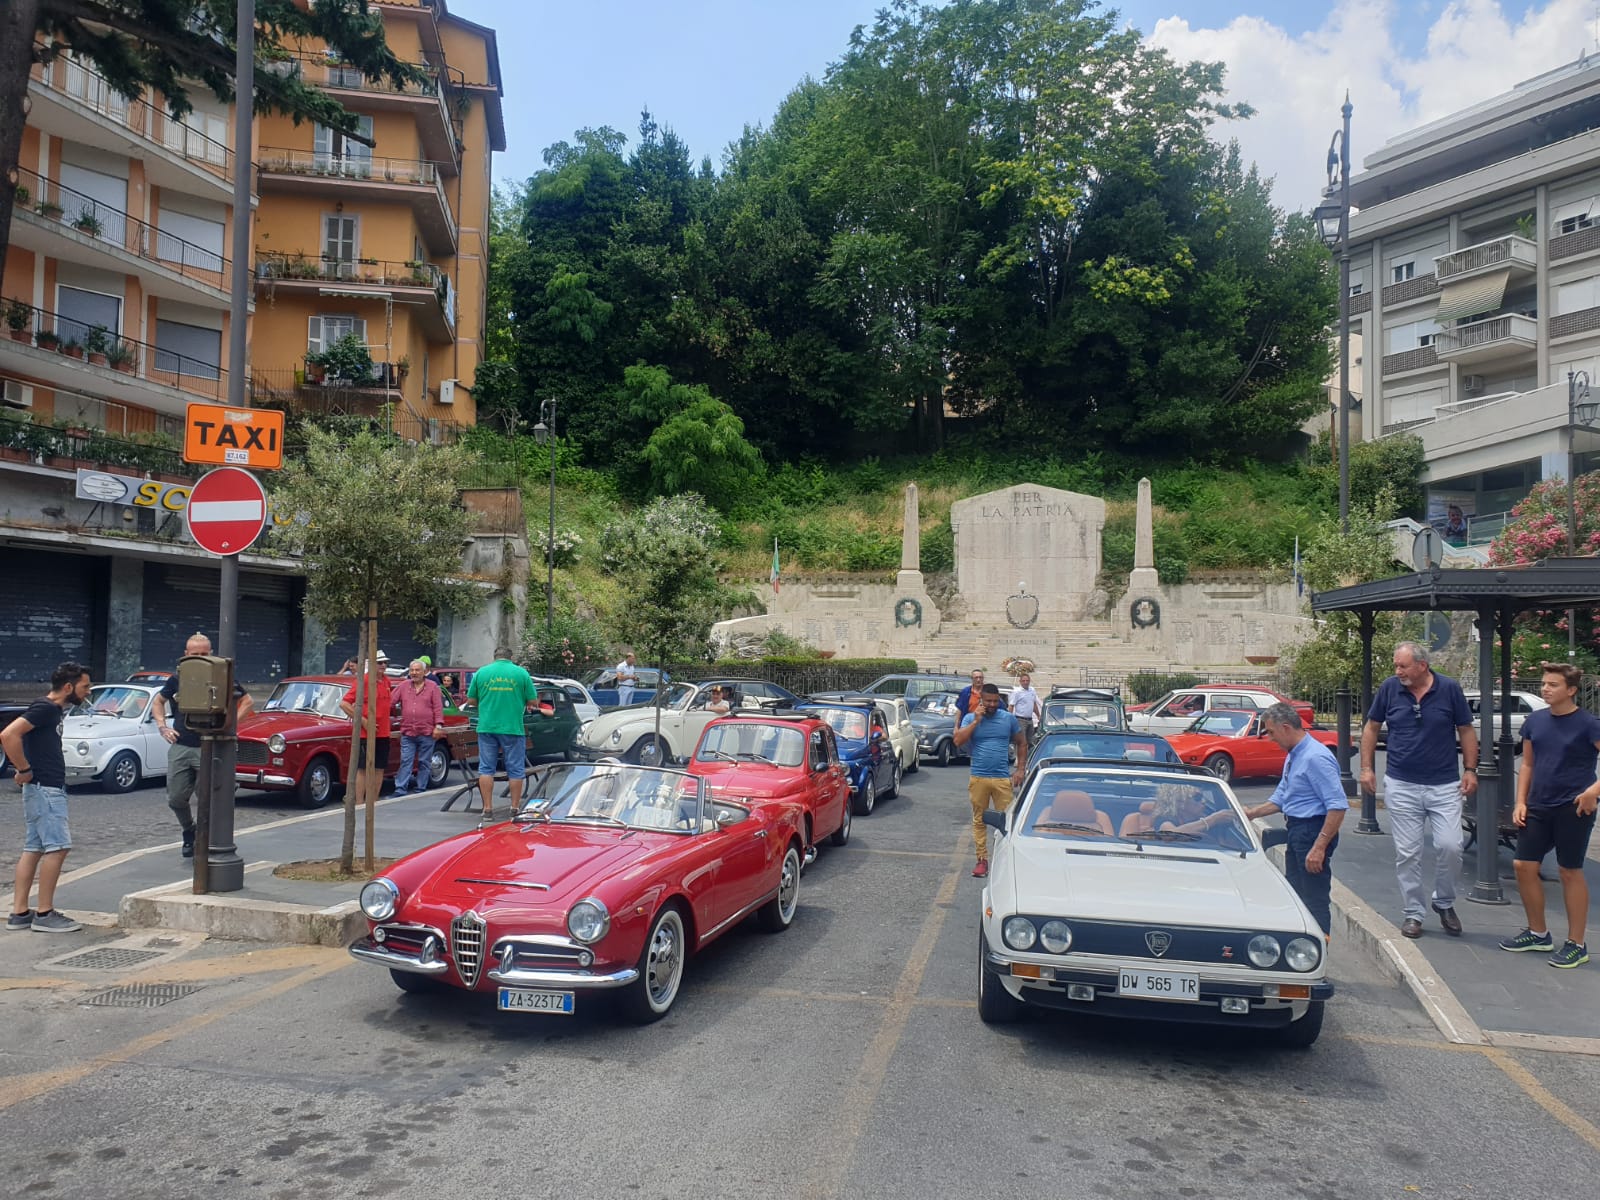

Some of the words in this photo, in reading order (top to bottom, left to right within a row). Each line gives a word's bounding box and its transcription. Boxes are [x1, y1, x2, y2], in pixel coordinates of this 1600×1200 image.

[194, 421, 276, 451] TAXI
[1013, 492, 1043, 503] PER
[982, 506, 1002, 518] LA
[1013, 505, 1073, 517] PATRIA
[1147, 976, 1171, 992] 565
[1180, 979, 1196, 994] TR
